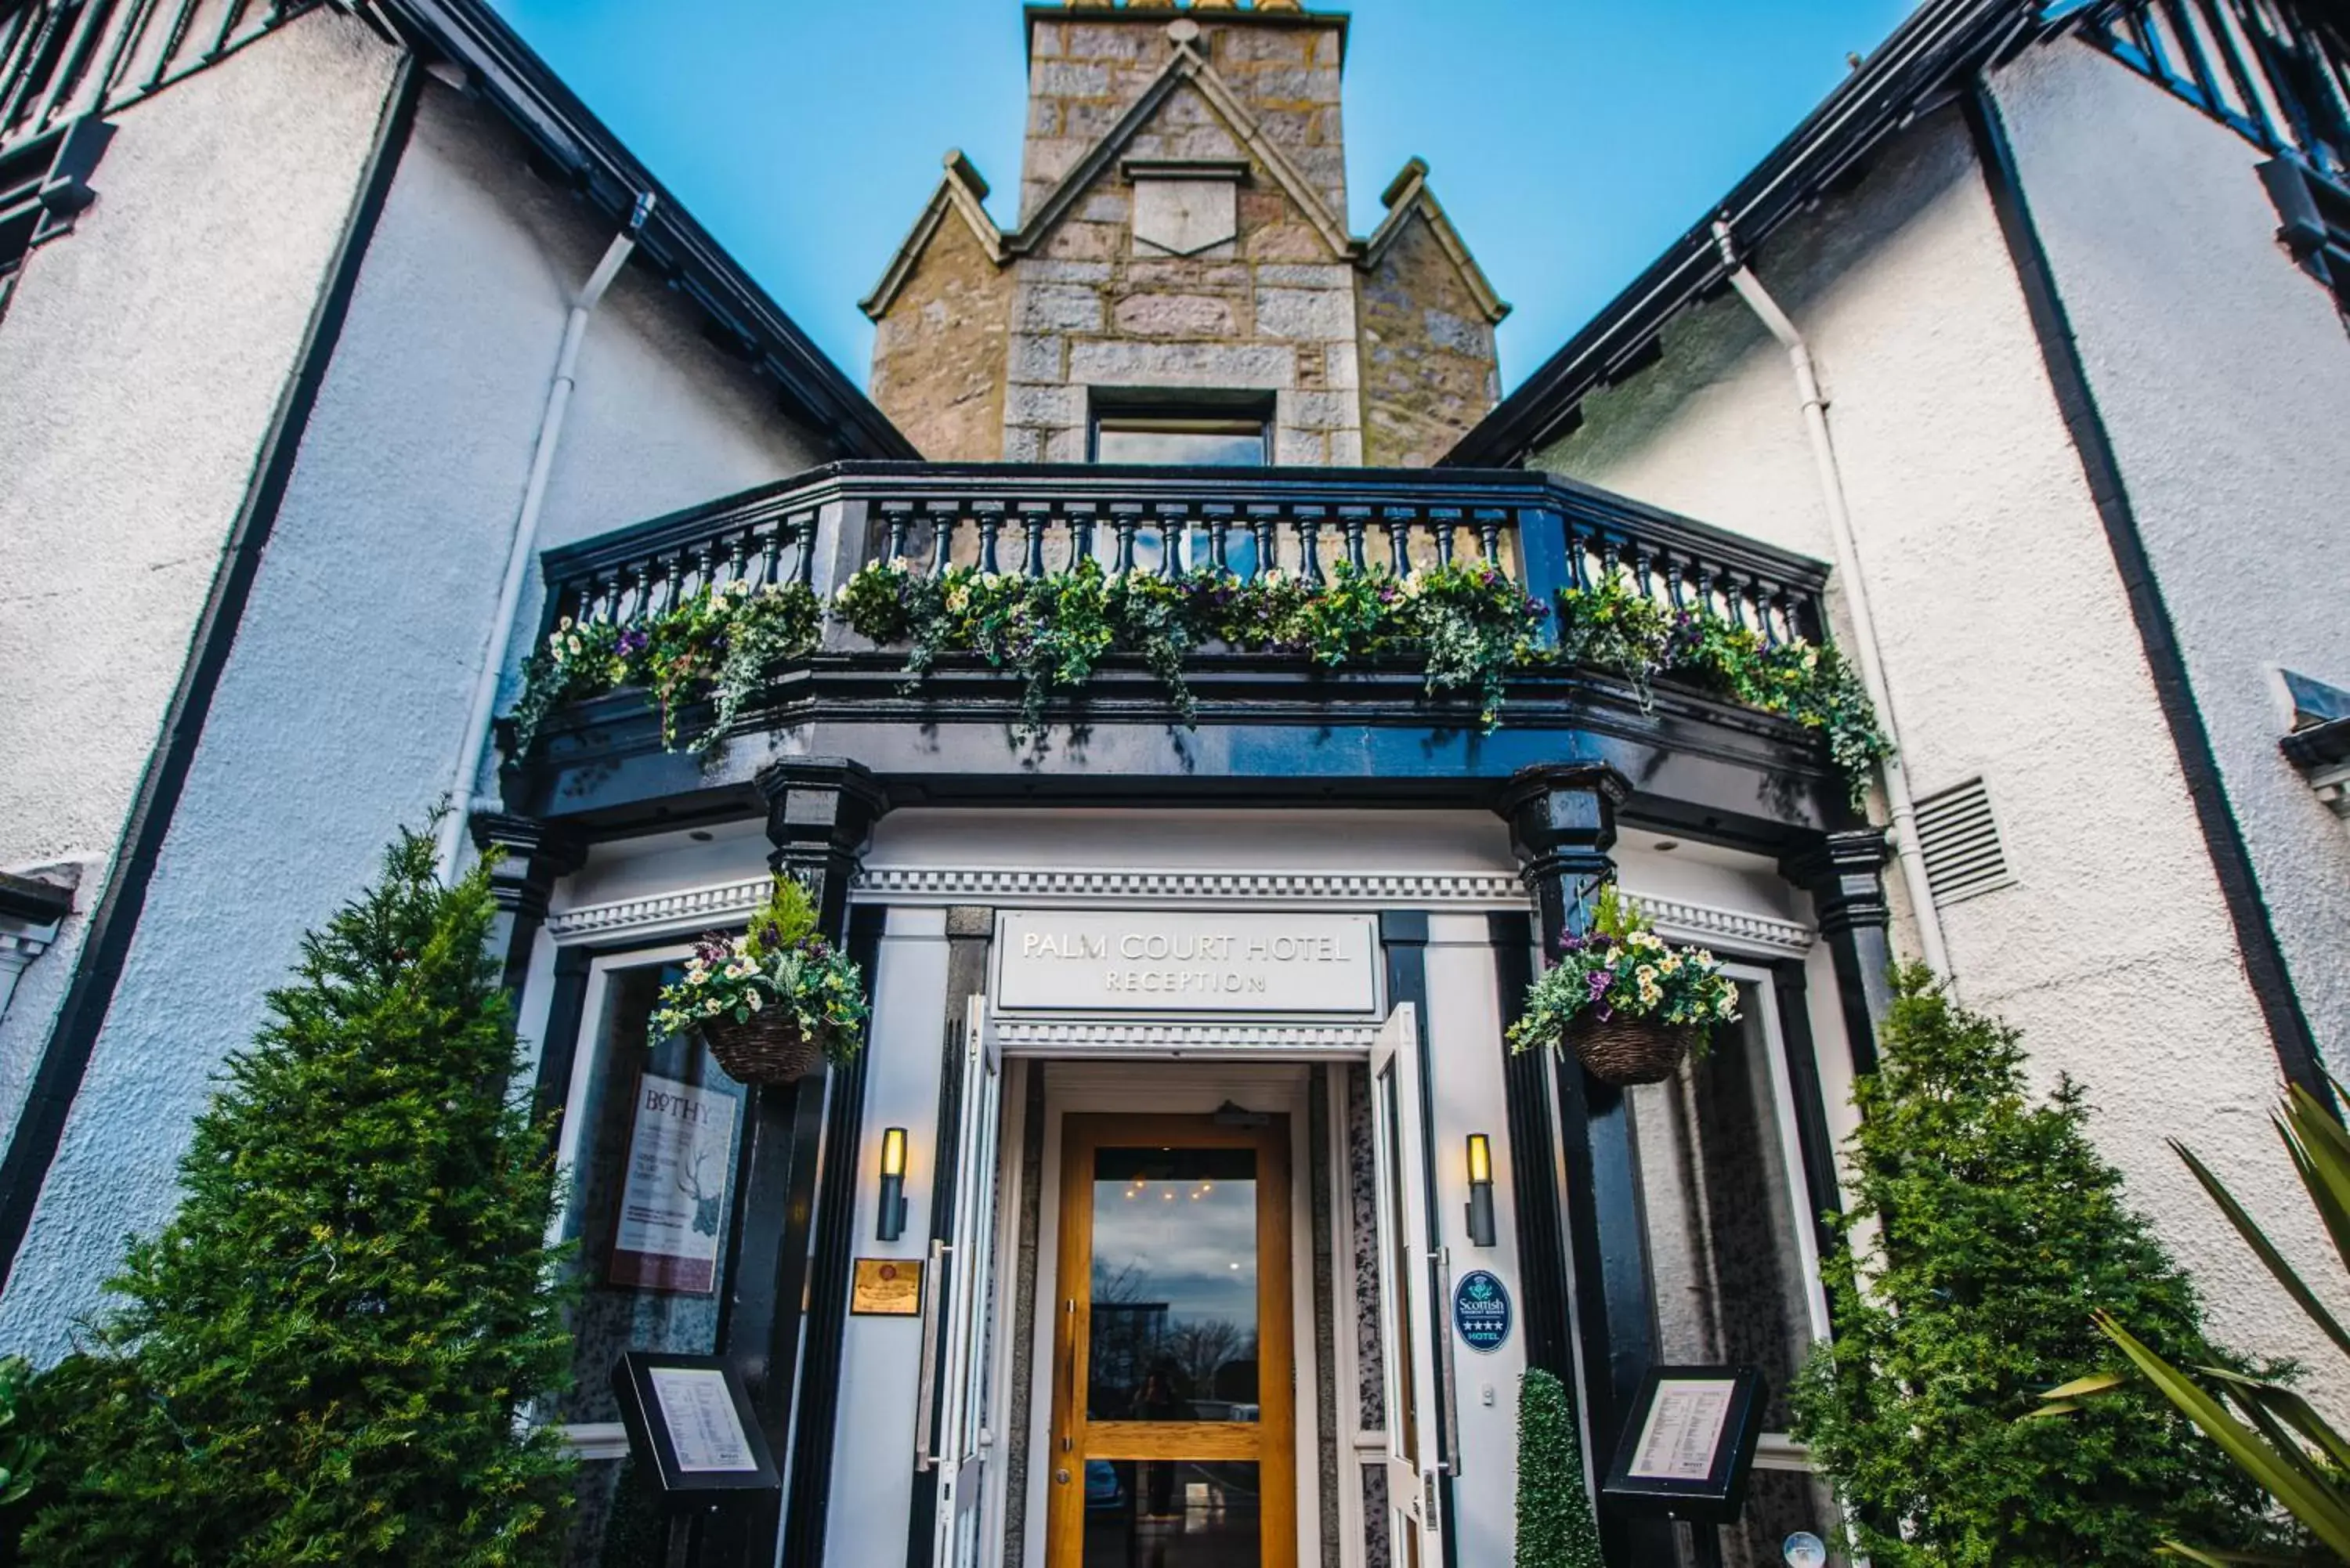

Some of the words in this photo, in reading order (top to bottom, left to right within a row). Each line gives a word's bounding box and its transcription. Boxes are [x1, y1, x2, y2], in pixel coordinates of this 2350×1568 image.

[1022, 932, 1107, 959] PALM
[1120, 933, 1236, 961] COURT
[1247, 934, 1351, 962] HOTEL
[1105, 970, 1266, 993] RECEPTION
[645, 1089, 711, 1124] BOTHY
[1459, 1298, 1504, 1311] Scottish
